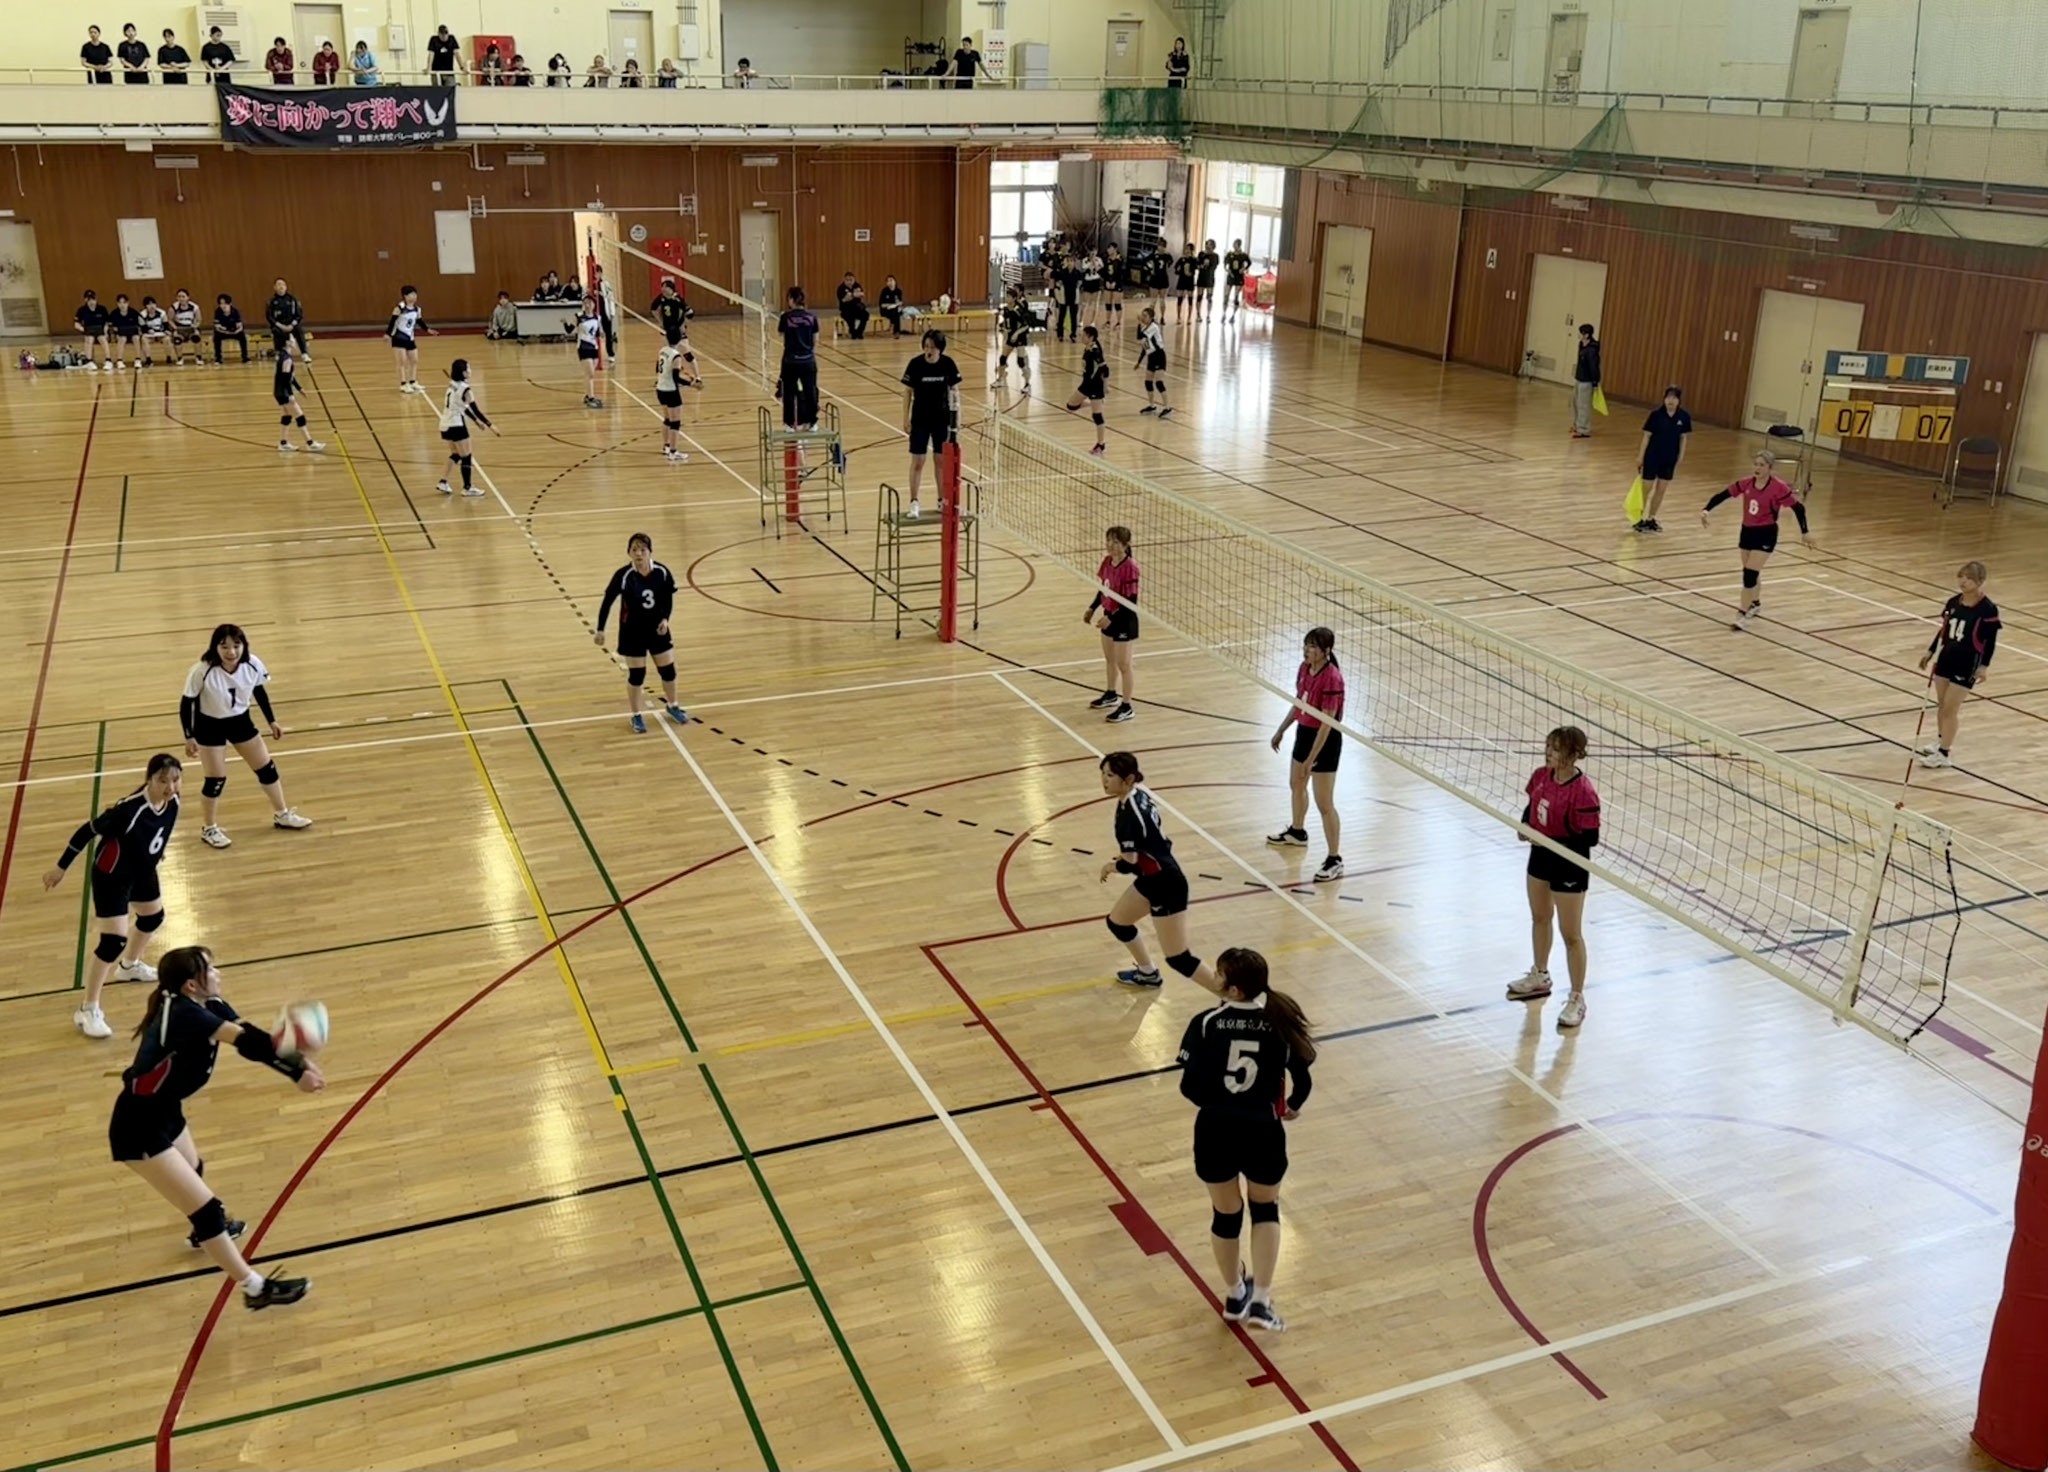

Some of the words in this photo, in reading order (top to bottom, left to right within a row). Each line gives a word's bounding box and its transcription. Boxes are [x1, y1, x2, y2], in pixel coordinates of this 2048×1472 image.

[226, 95, 423, 131] 夢に向かって翔べ
[641, 589, 655, 609] 3
[1948, 618, 1965, 642] 14
[228, 687, 236, 709] 1
[148, 826, 165, 855] 6
[1223, 1039, 1260, 1094] 5
